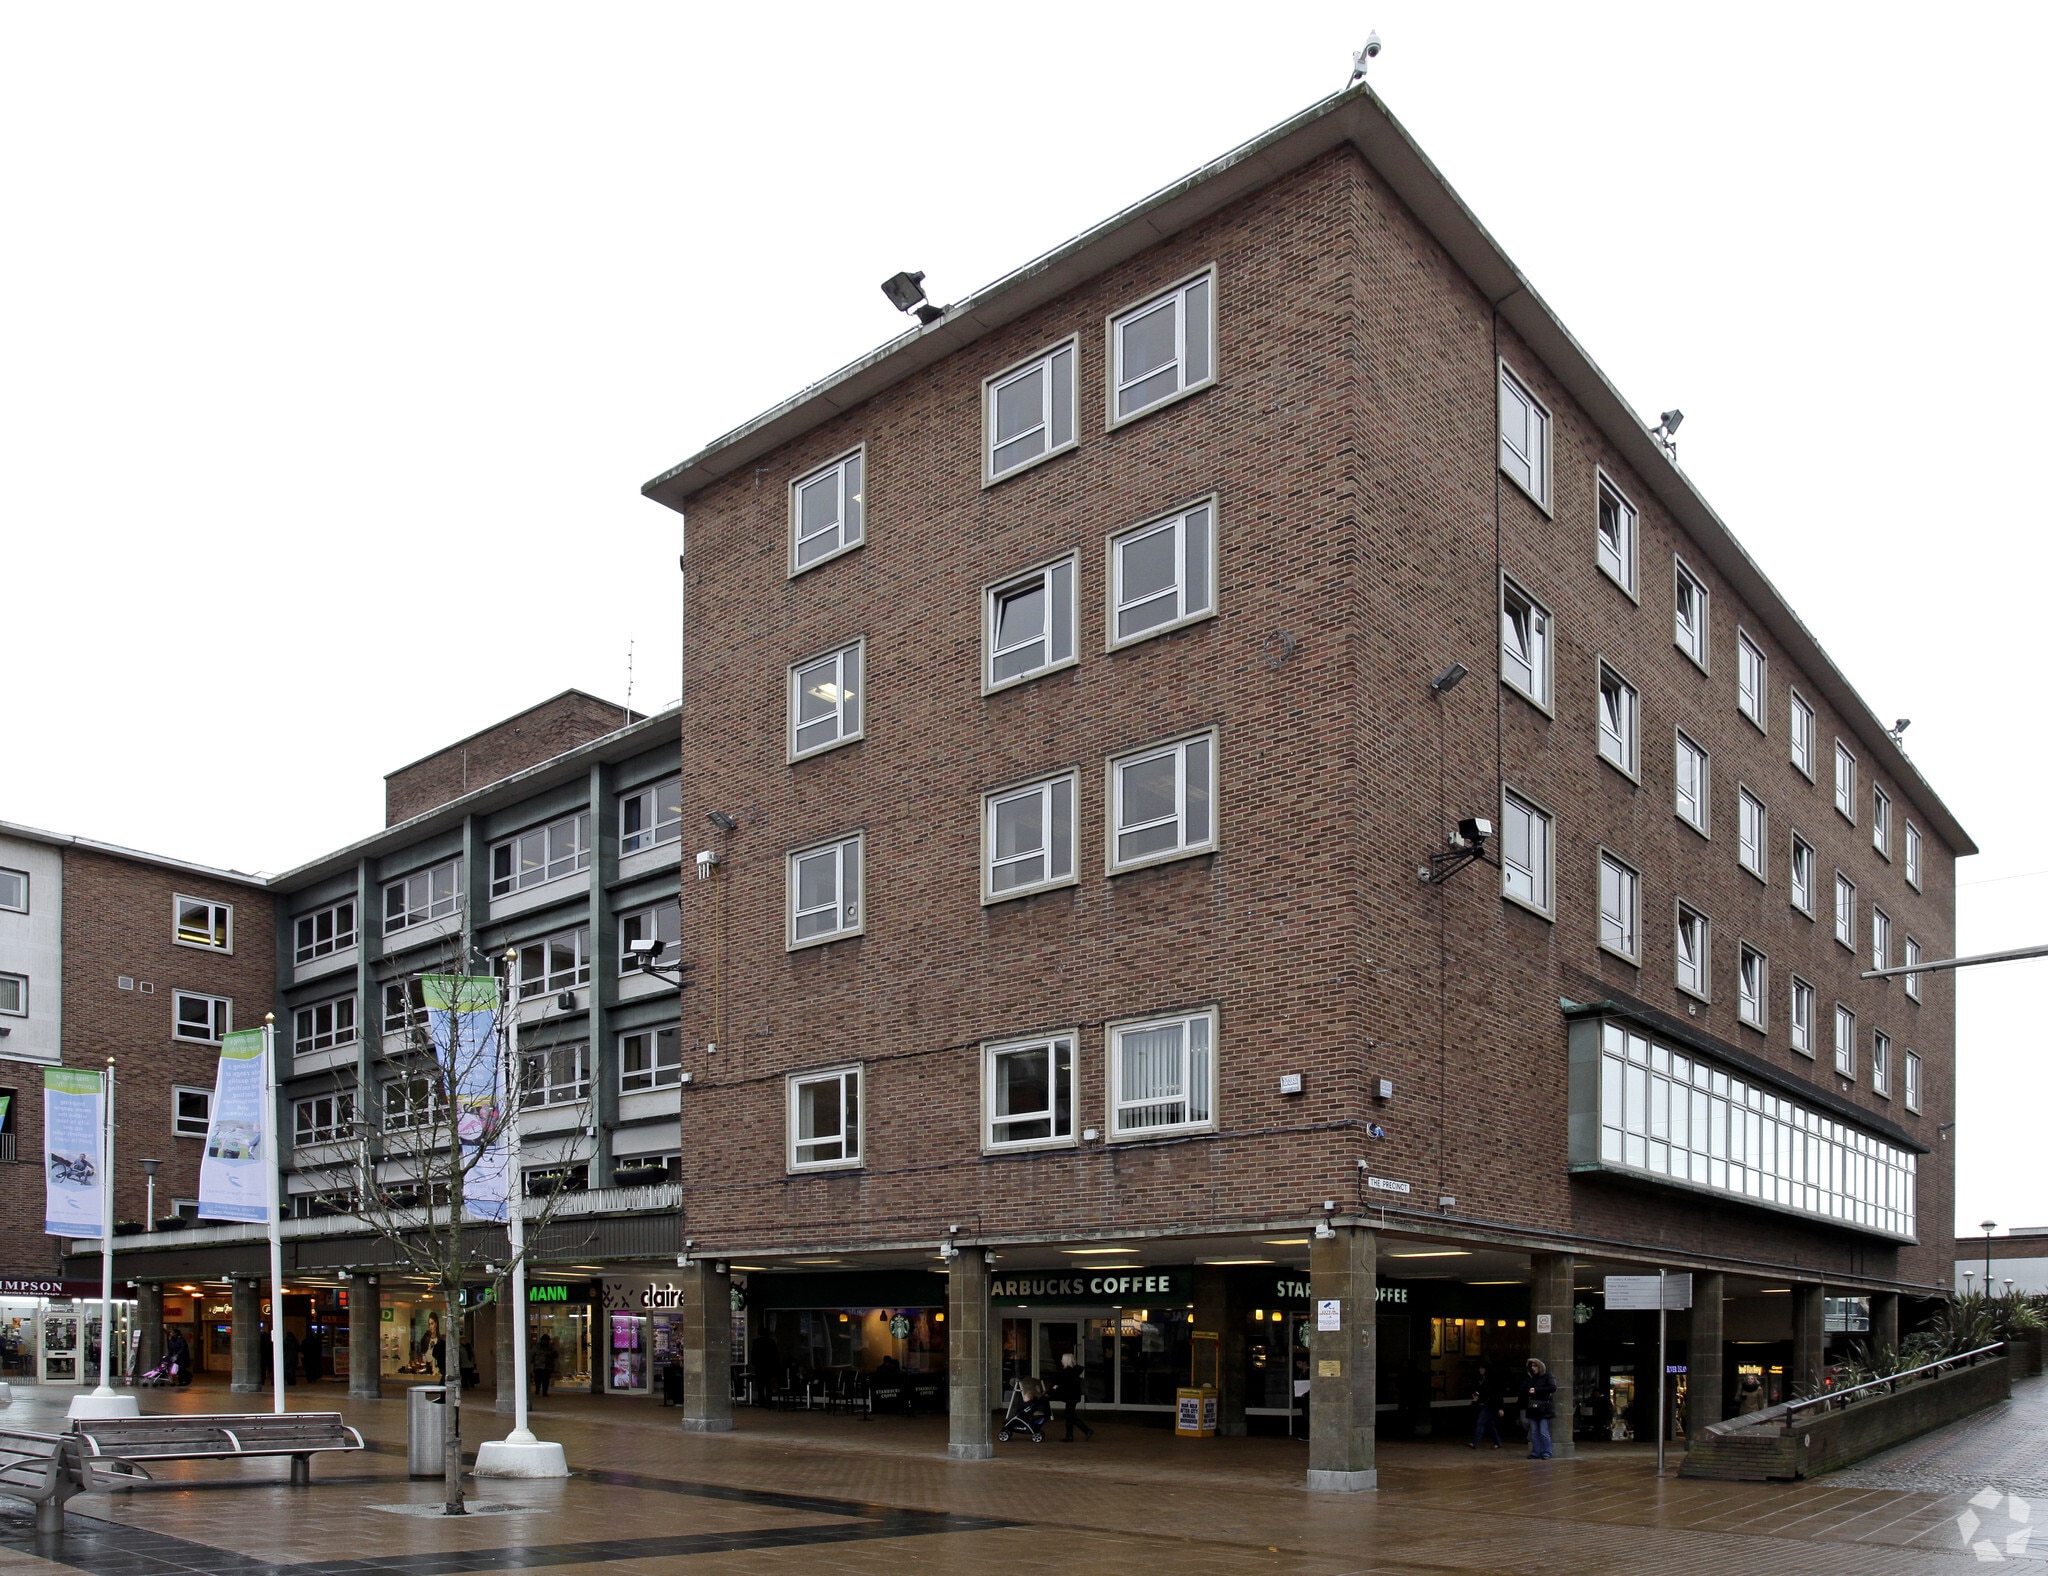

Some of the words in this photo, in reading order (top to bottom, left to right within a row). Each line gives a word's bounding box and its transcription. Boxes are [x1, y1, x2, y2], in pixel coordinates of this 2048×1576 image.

[1370, 1178, 1380, 1187] THE
[1382, 1180, 1408, 1191] PRECINCT
[1090, 1276, 1170, 1294] COFFEE
